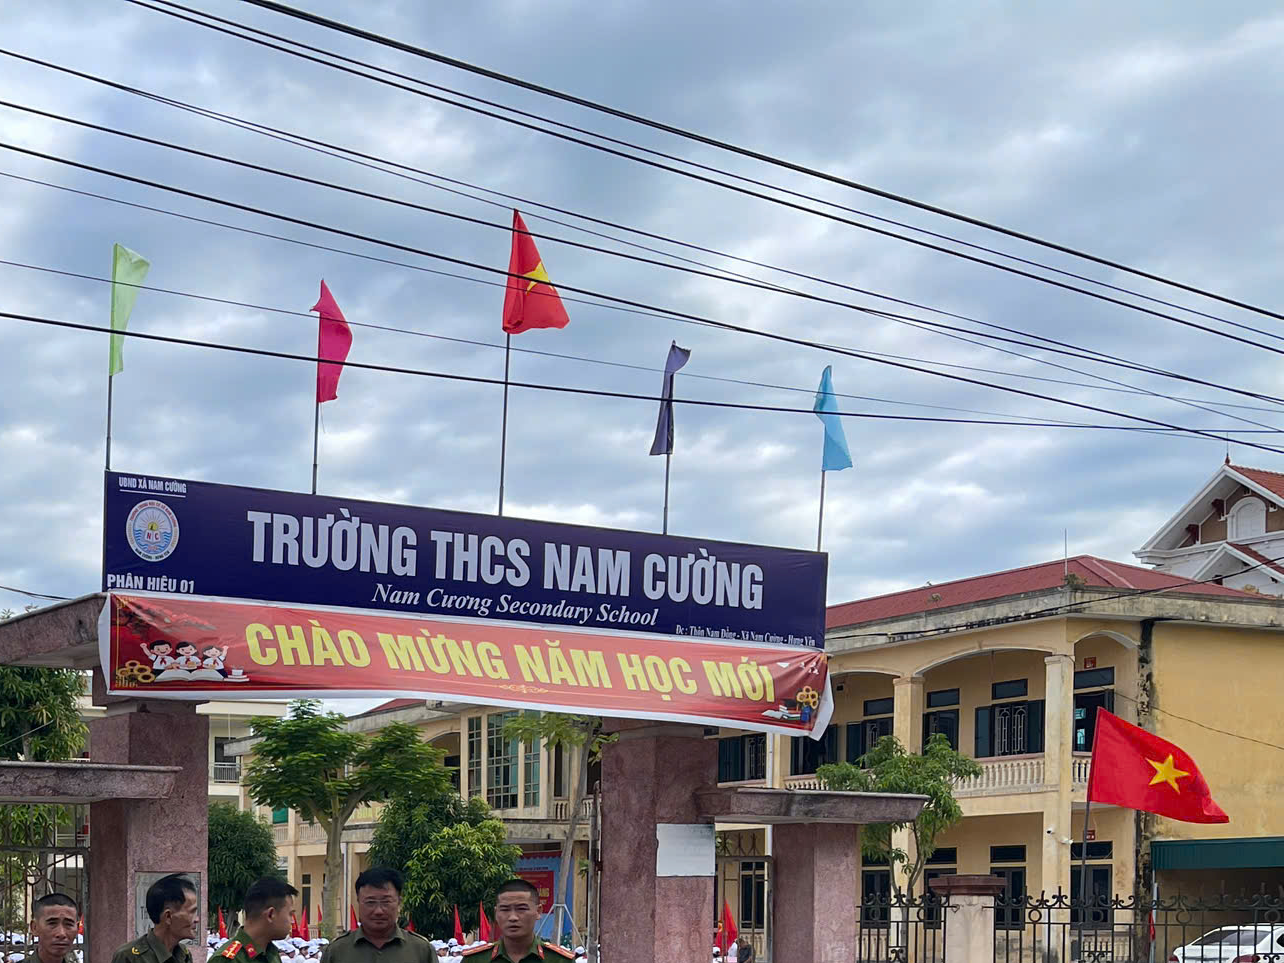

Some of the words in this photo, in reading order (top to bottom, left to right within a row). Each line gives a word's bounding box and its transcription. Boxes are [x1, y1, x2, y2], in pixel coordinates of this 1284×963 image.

[118, 476, 137, 488] UBND
[148, 479, 164, 491] NAM
[247, 508, 418, 577] TRƯỜNG
[430, 530, 531, 587] THCS
[543, 542, 631, 597] NAM
[643, 548, 764, 610] CƯỜNG
[106, 572, 144, 590] PHÂN
[180, 579, 195, 594] 01
[371, 583, 421, 605] Nam
[495, 595, 594, 624] Secondary
[596, 603, 659, 626] School
[706, 627, 720, 639] Nam
[750, 631, 764, 642] Nam
[245, 619, 371, 667] CHÀO
[376, 629, 510, 680] MỪNG
[514, 639, 613, 689] NĂM
[616, 652, 698, 701] HỌC
[702, 656, 776, 702] MỚI
